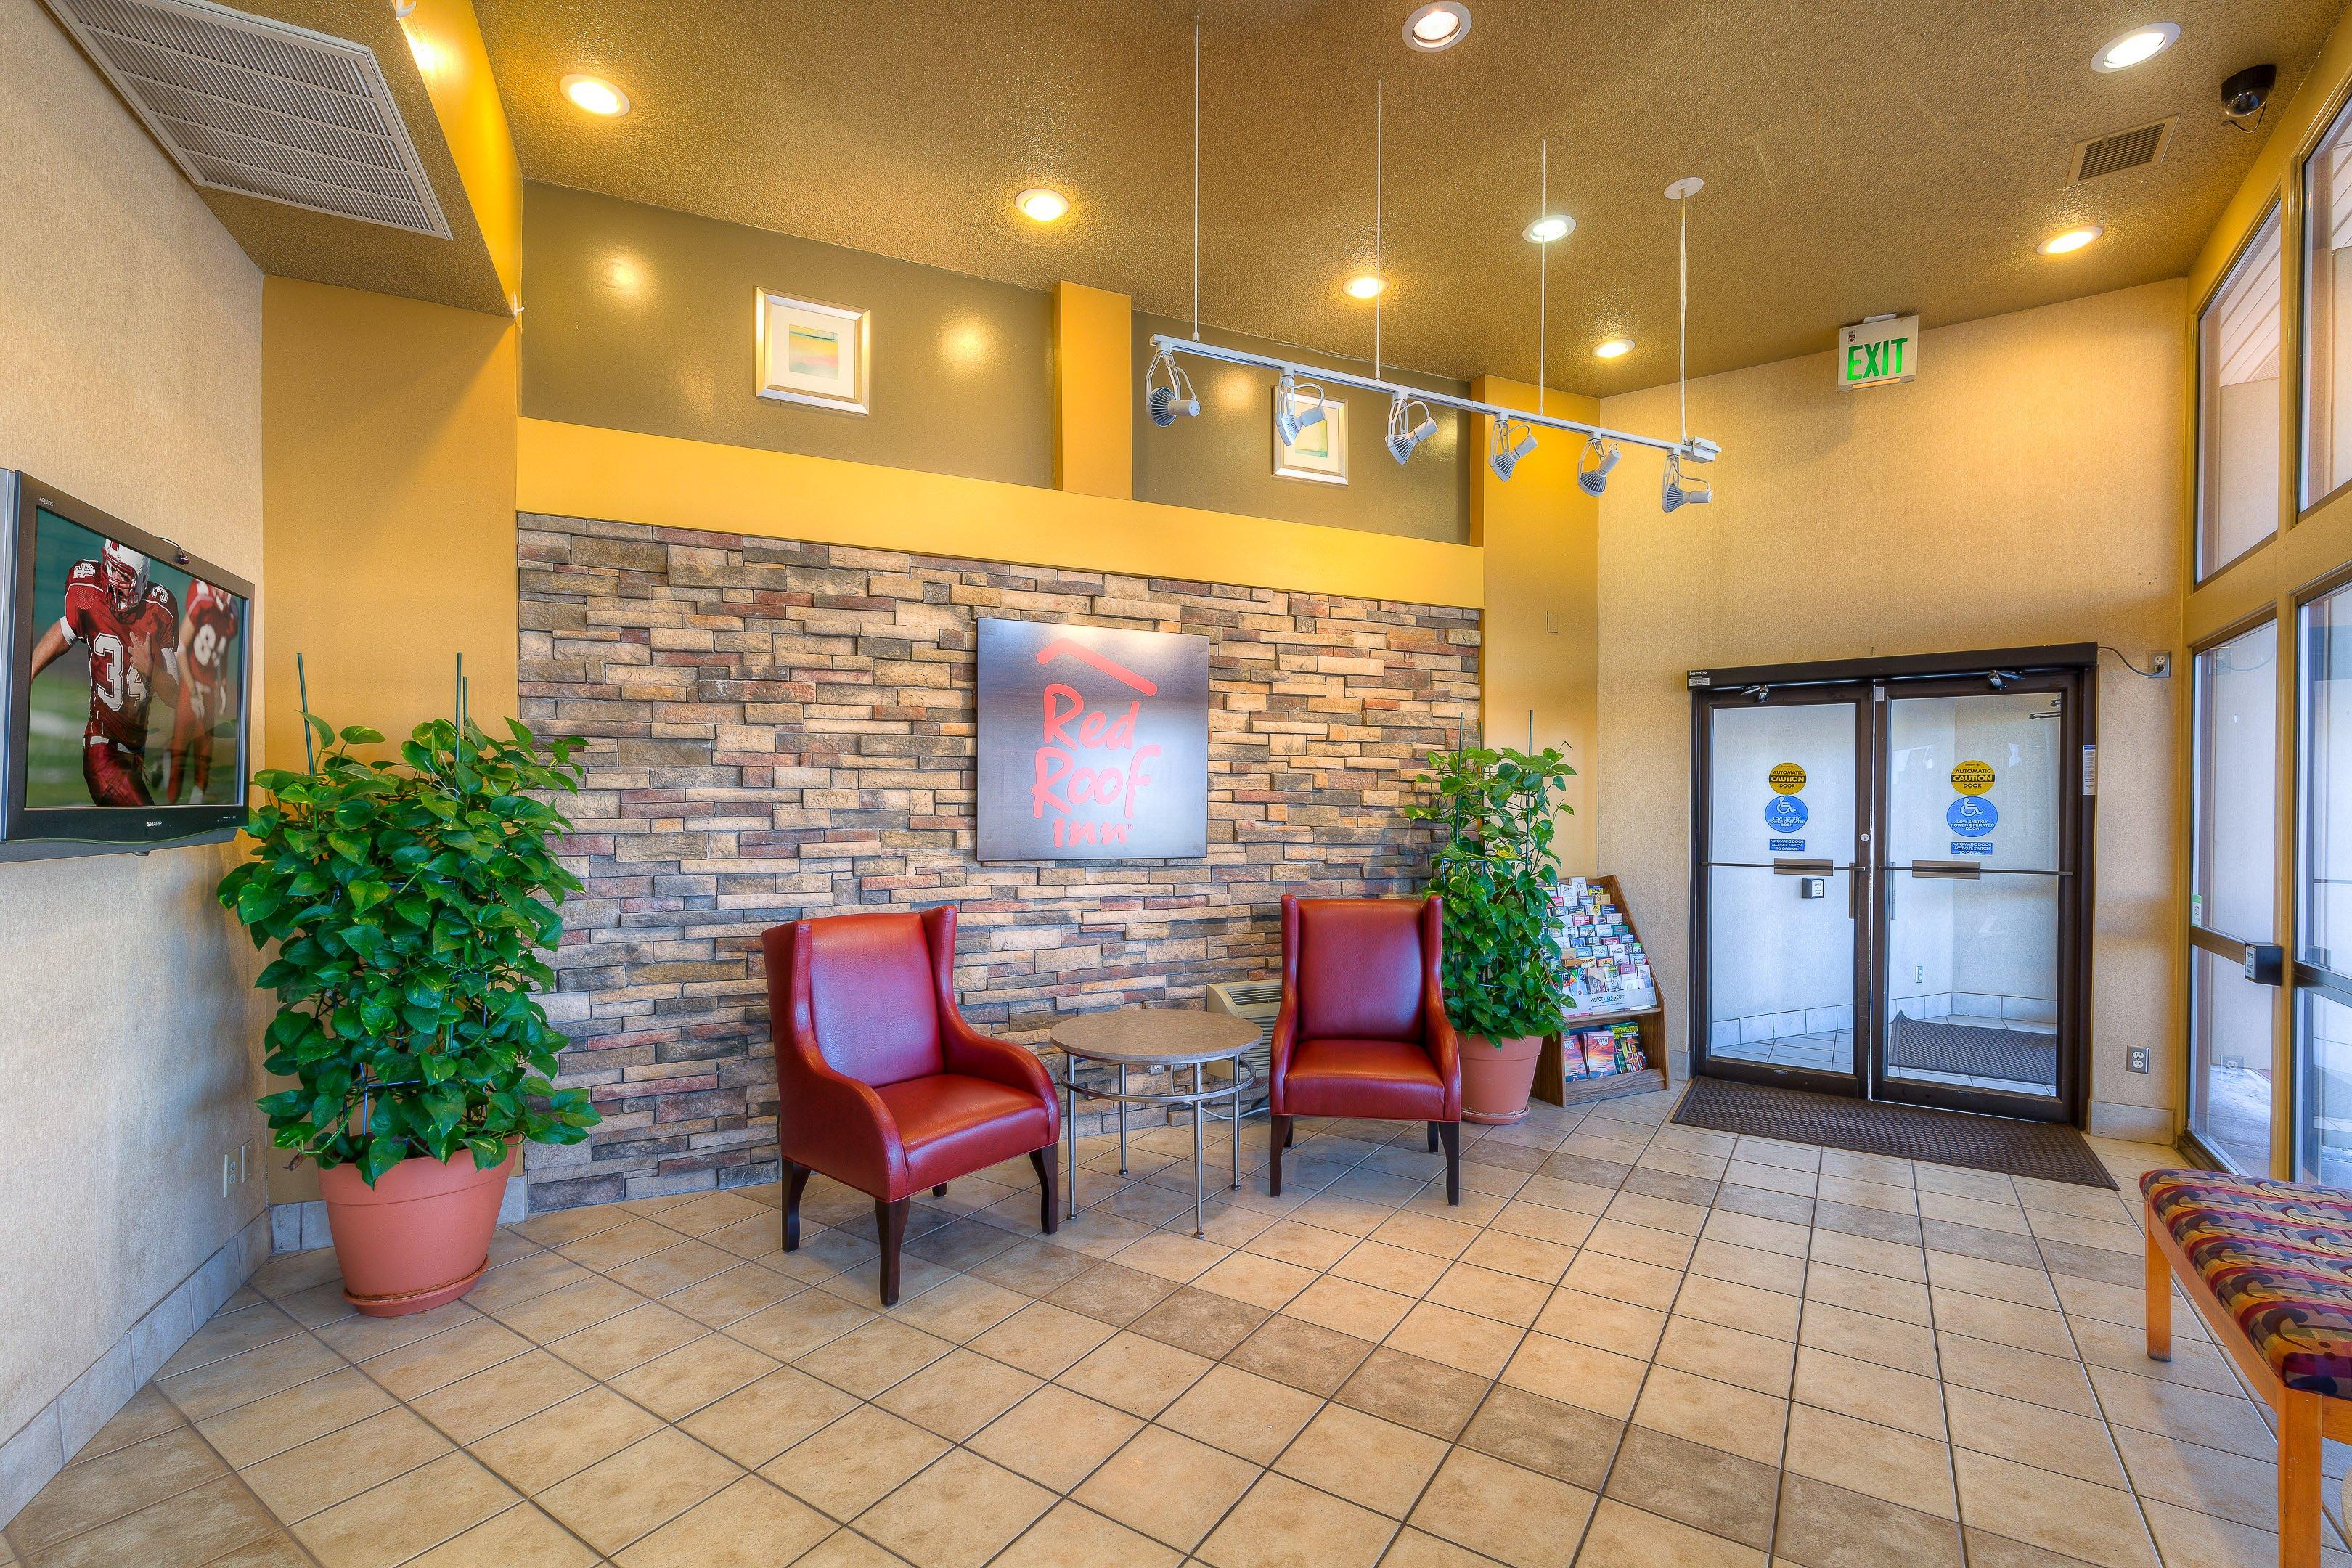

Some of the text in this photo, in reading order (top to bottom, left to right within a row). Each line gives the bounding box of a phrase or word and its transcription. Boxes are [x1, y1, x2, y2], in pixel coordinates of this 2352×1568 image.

[1847, 337, 1908, 381] EXIT
[1043, 683, 1140, 751] Red
[1031, 744, 1161, 820] Roof
